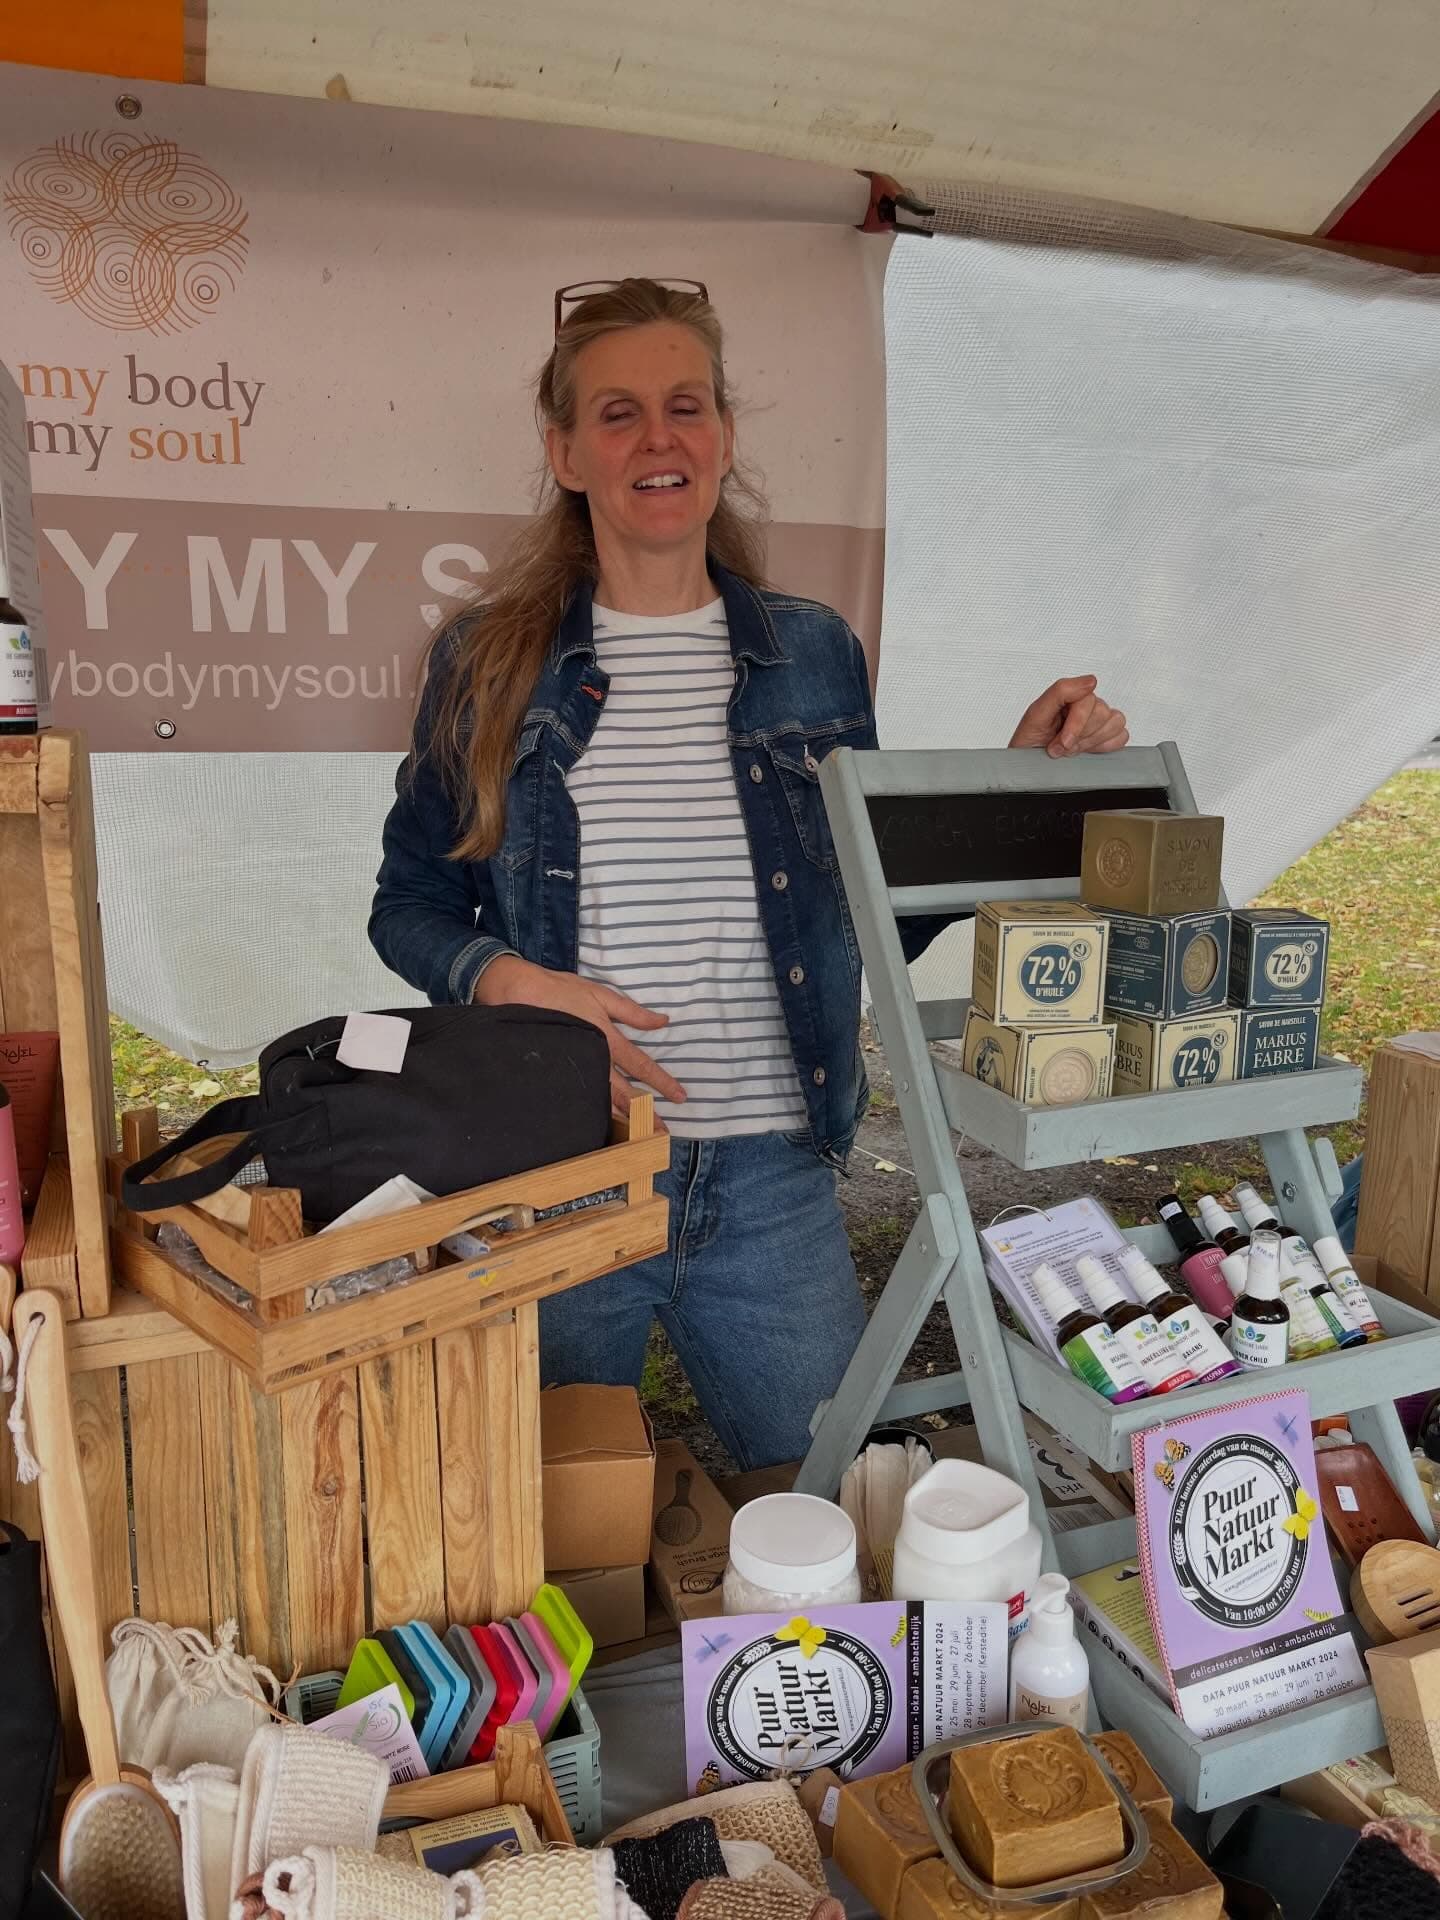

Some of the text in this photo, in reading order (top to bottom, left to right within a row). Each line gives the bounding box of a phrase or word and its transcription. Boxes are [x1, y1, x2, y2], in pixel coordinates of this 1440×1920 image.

[19, 355, 265, 426] my body
[26, 417, 245, 472] my soul
[187, 535, 377, 635] MY
[1168, 837, 1211, 853] SAVON
[1179, 858, 1196, 874] DE
[1035, 988, 1064, 997] D'HUILE
[1255, 1032, 1307, 1050] MARIUS
[1259, 1016, 1307, 1029] SAVON DE MARSEILLE
[1253, 1047, 1305, 1069] FABRE
[1182, 1342, 1203, 1359] BALANS
[1250, 1355, 1268, 1364] CHILD
[1197, 1447, 1228, 1474] zaterdag
[1226, 1443, 1240, 1454] van
[1241, 1441, 1250, 1451] de
[1250, 1444, 1274, 1461] maand
[1203, 1476, 1257, 1523] Puur
[1203, 1494, 1280, 1554] Natuur
[1204, 1523, 1274, 1585] Markt
[1224, 1555, 1302, 1621] Van 10:00 tot 17:00 uur
[911, 1615, 922, 1677] ambachtelijk
[964, 1616, 974, 1729] 28 september 26 oktober
[978, 1616, 988, 1727] 21 december (Kersteditie)
[1190, 1655, 1244, 1680] delicatessen
[1251, 1642, 1277, 1658] lokaal
[1284, 1623, 1337, 1649] ambachtelijk
[716, 1693, 725, 1705] de
[720, 1664, 743, 1694] maand
[838, 1640, 886, 1735] Van 10:00 tot 17:00 uur
[911, 1686, 920, 1714] lokaal
[936, 1622, 944, 1744] UUR NATUUR MARKT 2024
[950, 1630, 960, 1727] 25 mei 29 juni 27 juli
[1202, 1650, 1339, 1704] DATA PUUR NATUUR MARKT 2024
[1214, 1669, 1338, 1718] 30 maart 25 mei 29 juni 27 juli
[716, 1707, 724, 1722] van
[754, 1687, 785, 1750] Puur
[776, 1660, 812, 1751] Natuur
[803, 1669, 844, 1752] Markt
[1204, 1728, 1216, 1738] 31
[1217, 1716, 1252, 1735] augustus
[1268, 1695, 1309, 1718] september
[1314, 1689, 1325, 1699] 26
[1326, 1679, 1355, 1695] oktober
[716, 1722, 741, 1759] zaterdag
